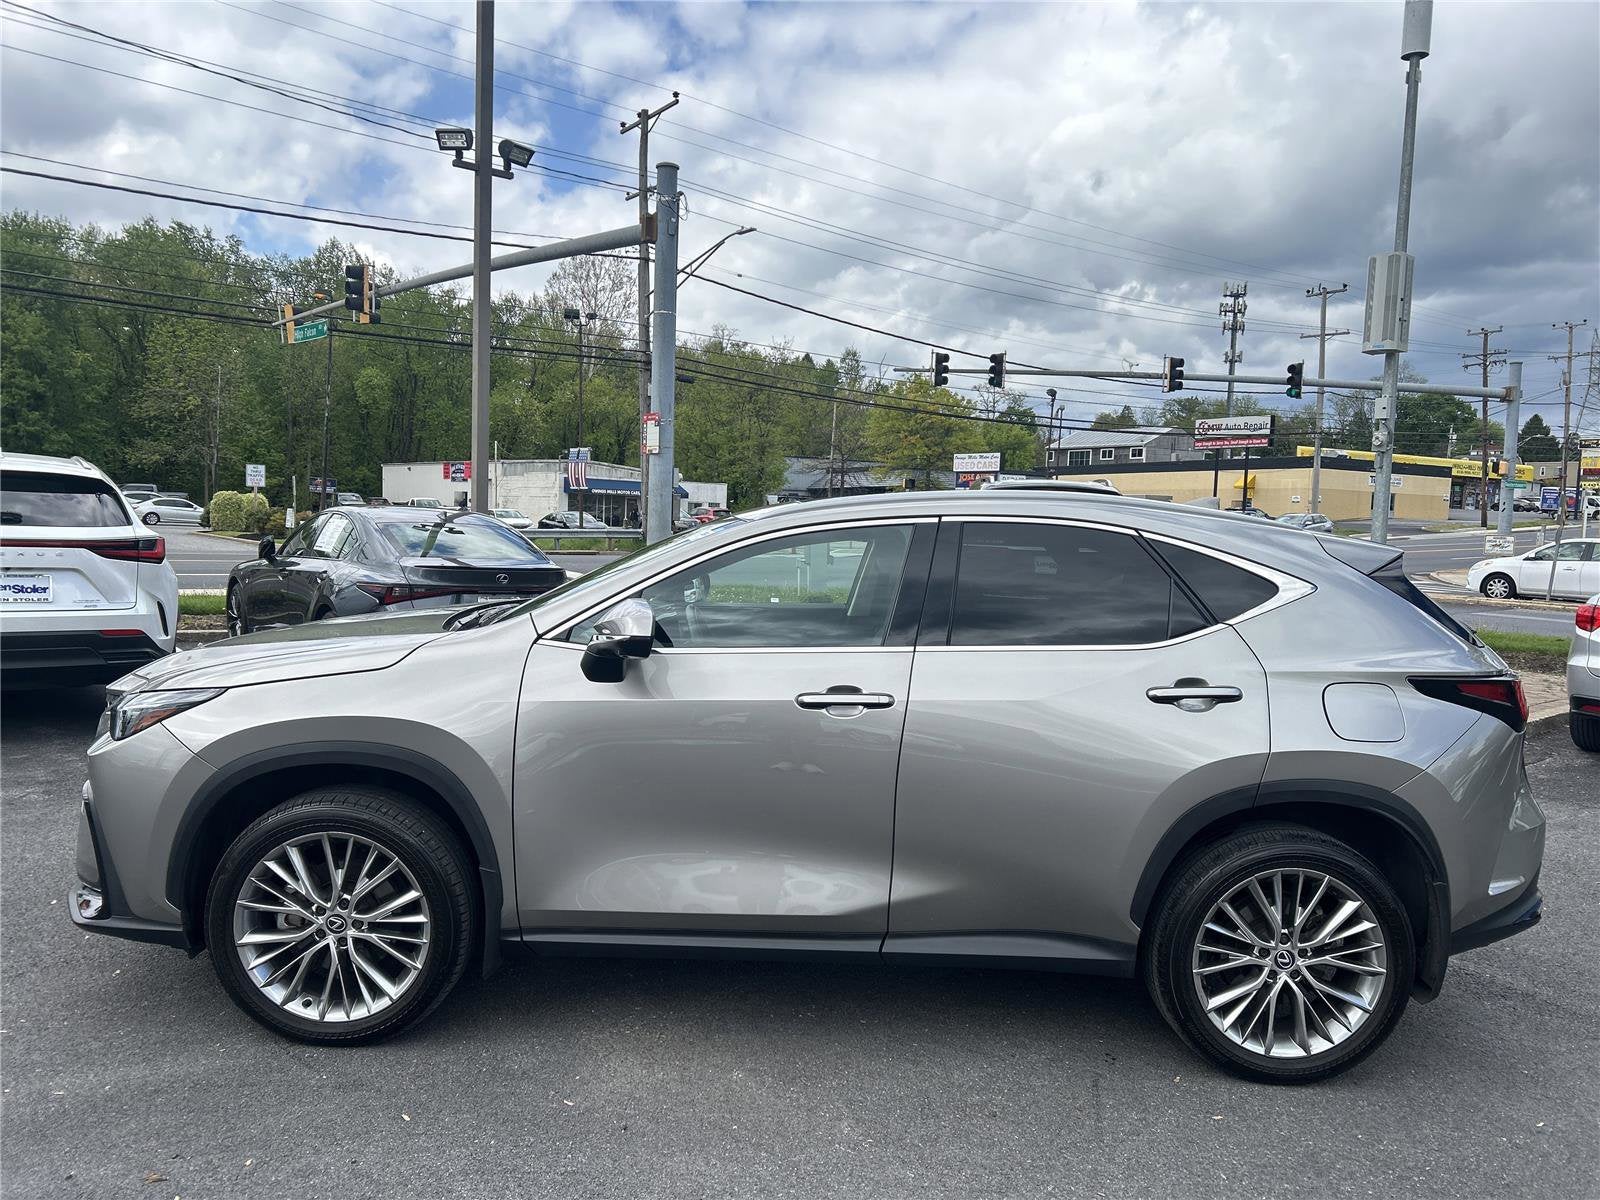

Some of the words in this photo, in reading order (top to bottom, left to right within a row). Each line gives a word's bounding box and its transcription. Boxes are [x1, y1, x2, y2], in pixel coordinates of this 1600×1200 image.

[1224, 423, 1242, 431] Auto
[1243, 420, 1269, 433] Repair
[955, 460, 976, 470] USED
[976, 460, 999, 470] CARS
